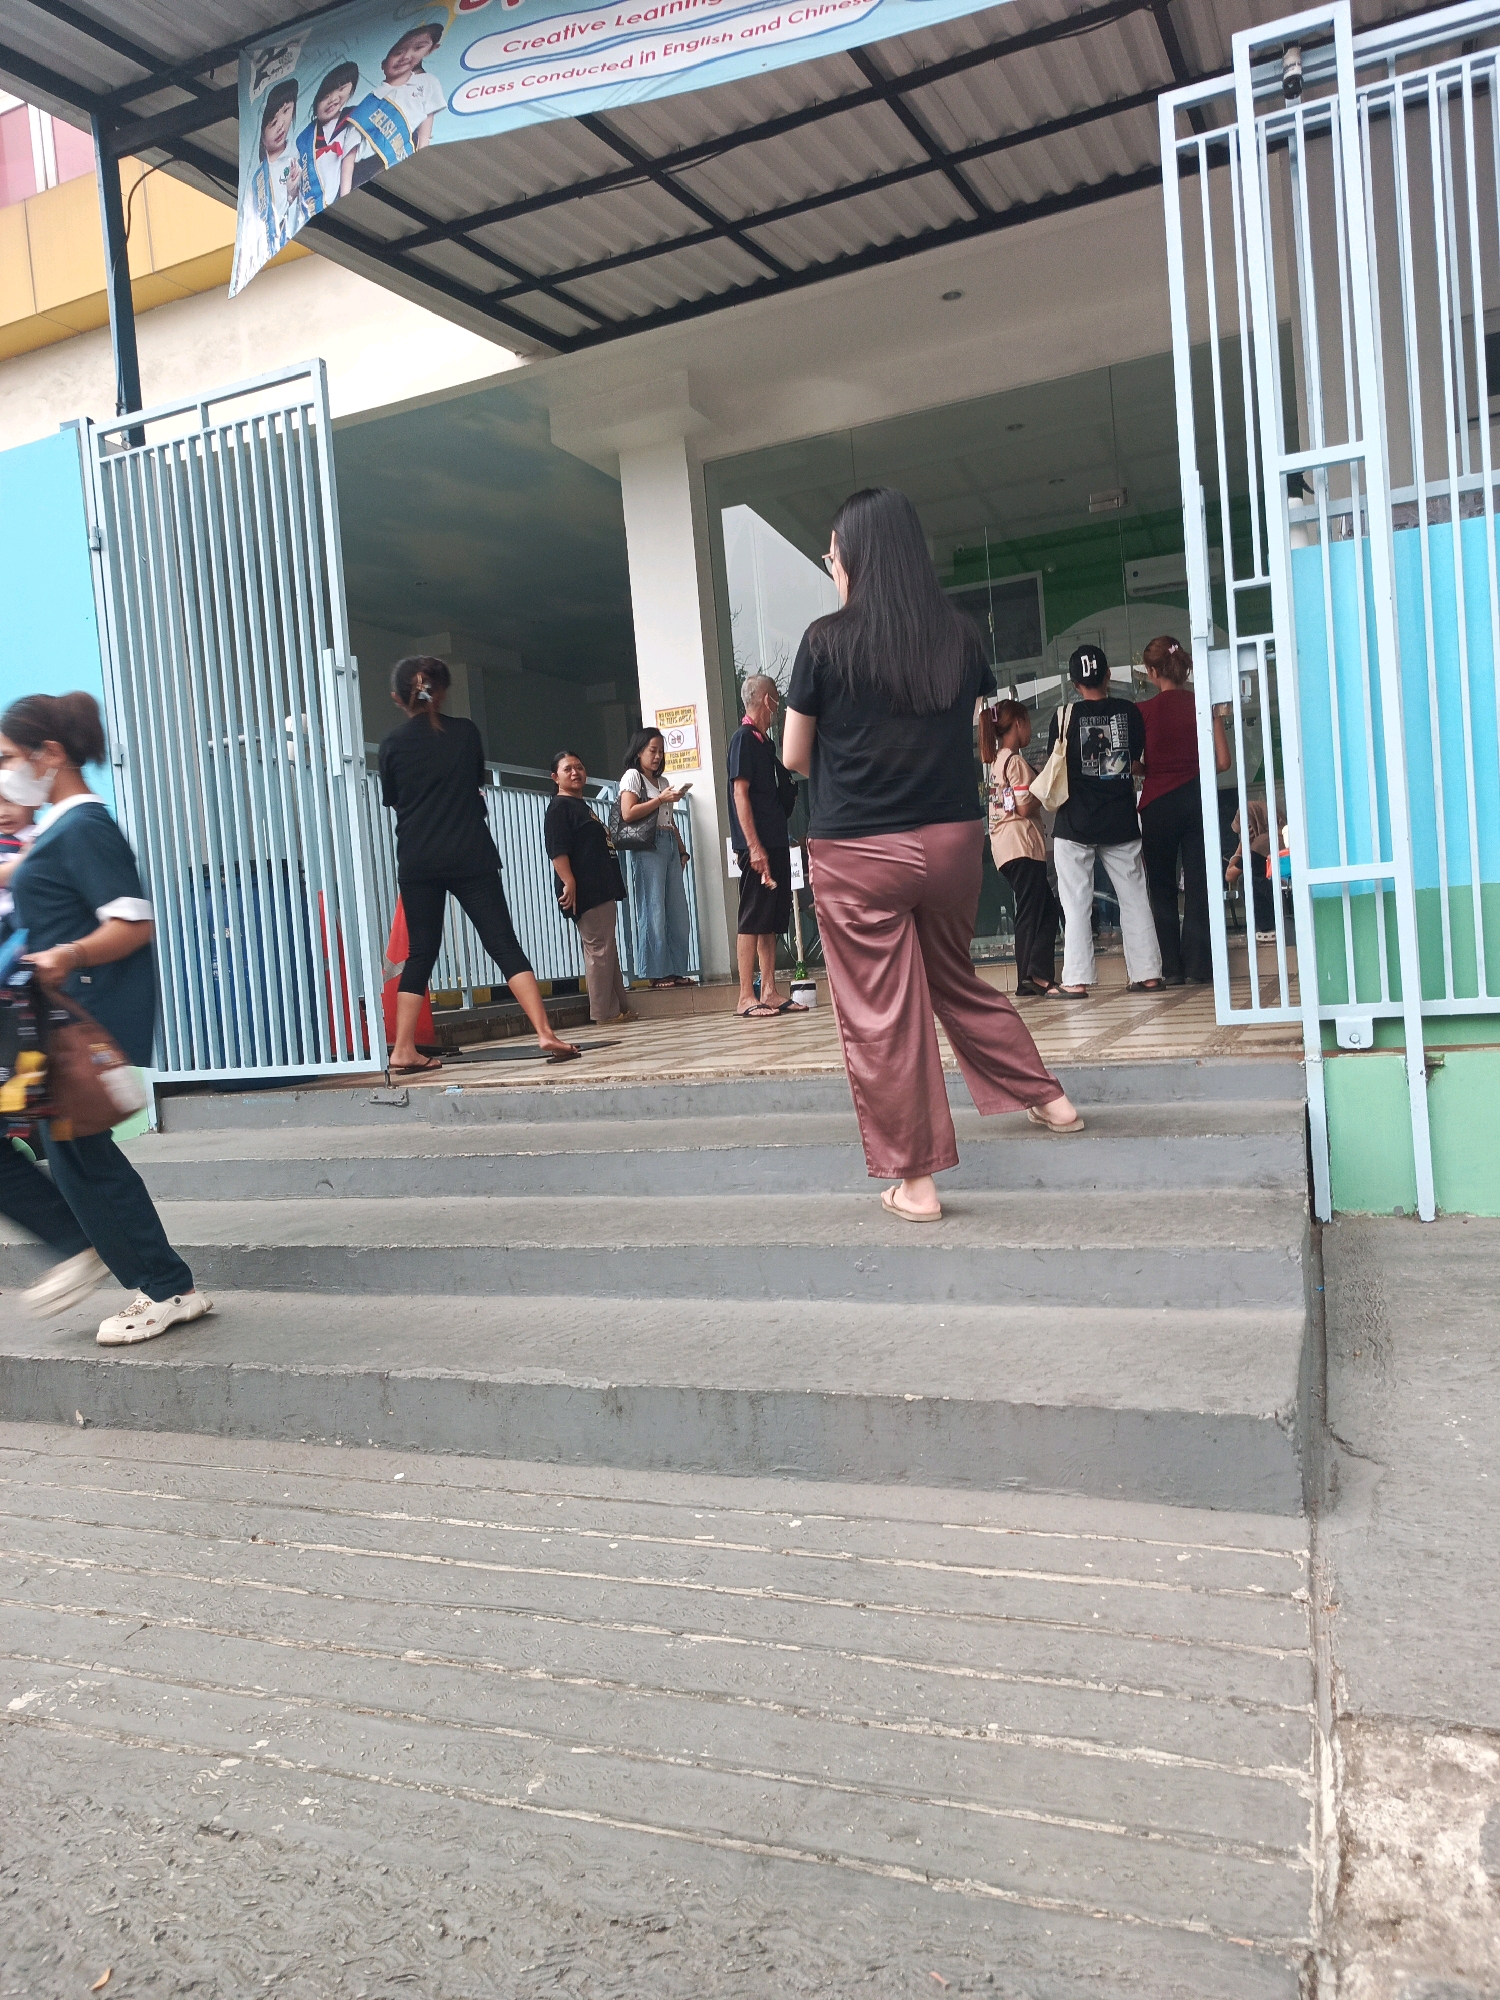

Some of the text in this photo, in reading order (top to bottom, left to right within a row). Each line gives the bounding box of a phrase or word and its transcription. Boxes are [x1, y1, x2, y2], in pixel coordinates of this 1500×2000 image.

[465, 81, 515, 99] Class
[521, 55, 633, 87] Conducted
[639, 49, 656, 65] in
[662, 33, 733, 57] English
[740, 16, 781, 38] and
[503, 21, 606, 53] Creative
